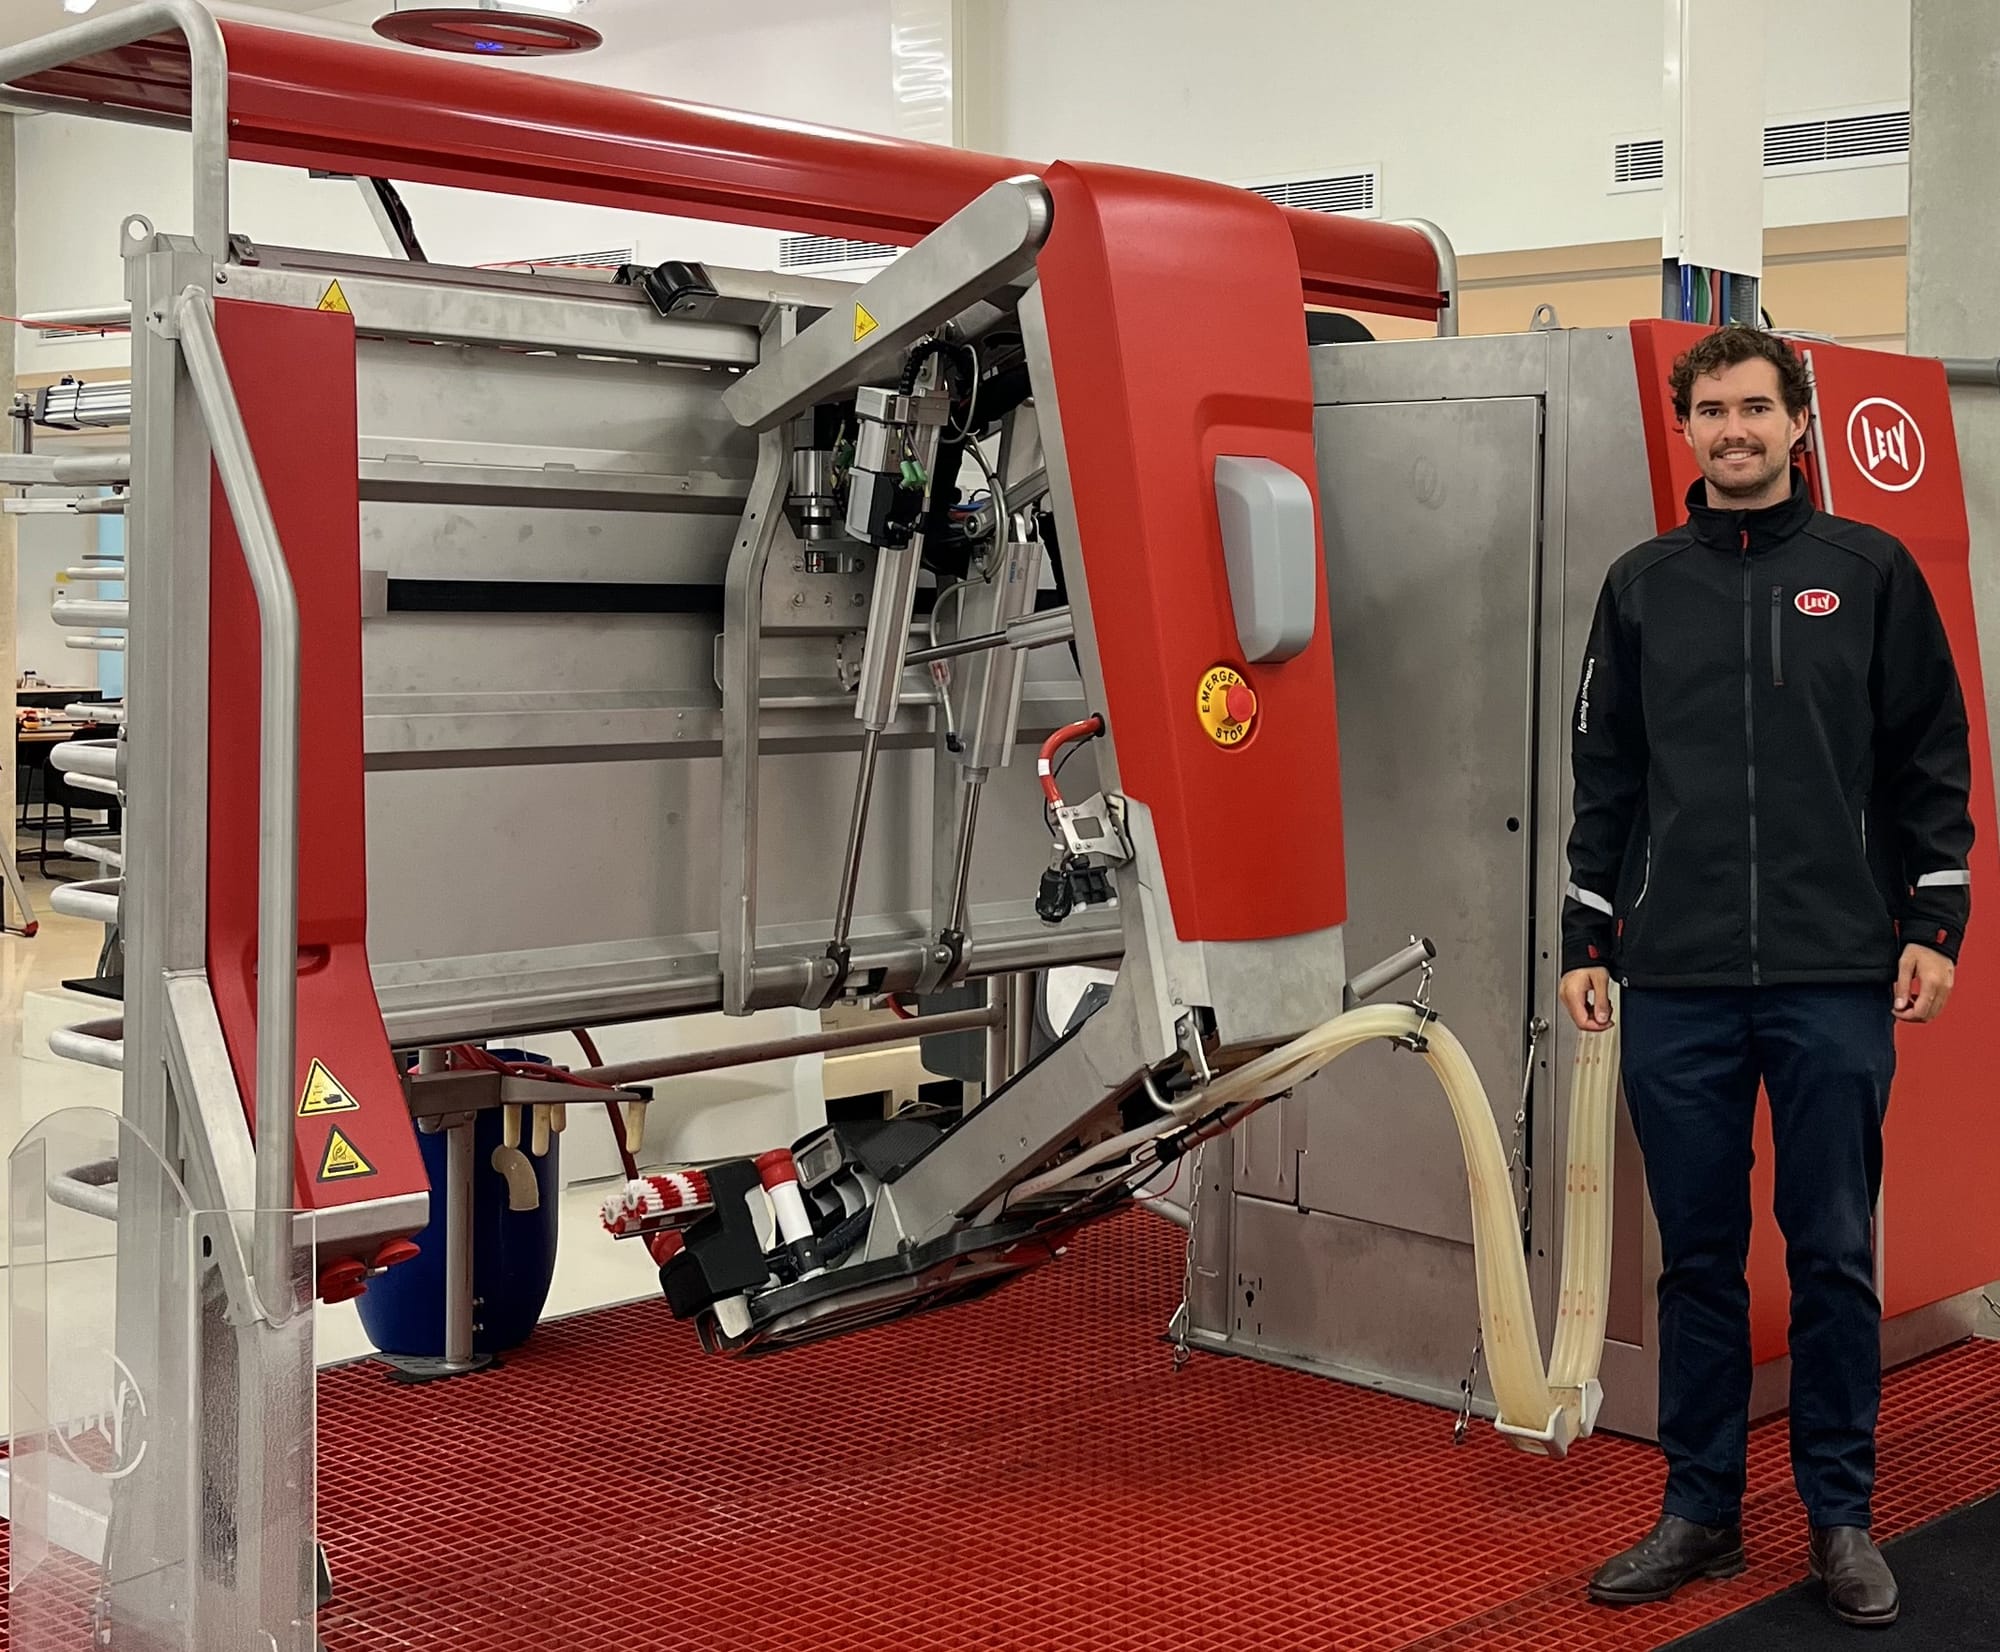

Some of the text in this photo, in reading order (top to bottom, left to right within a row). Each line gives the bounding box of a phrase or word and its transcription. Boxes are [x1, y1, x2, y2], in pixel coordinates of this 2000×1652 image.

[1861, 415, 1909, 472] LELY
[1804, 594, 1831, 610] LELY
[1201, 670, 1243, 713] EMERGE
[1215, 724, 1243, 742] STOP
